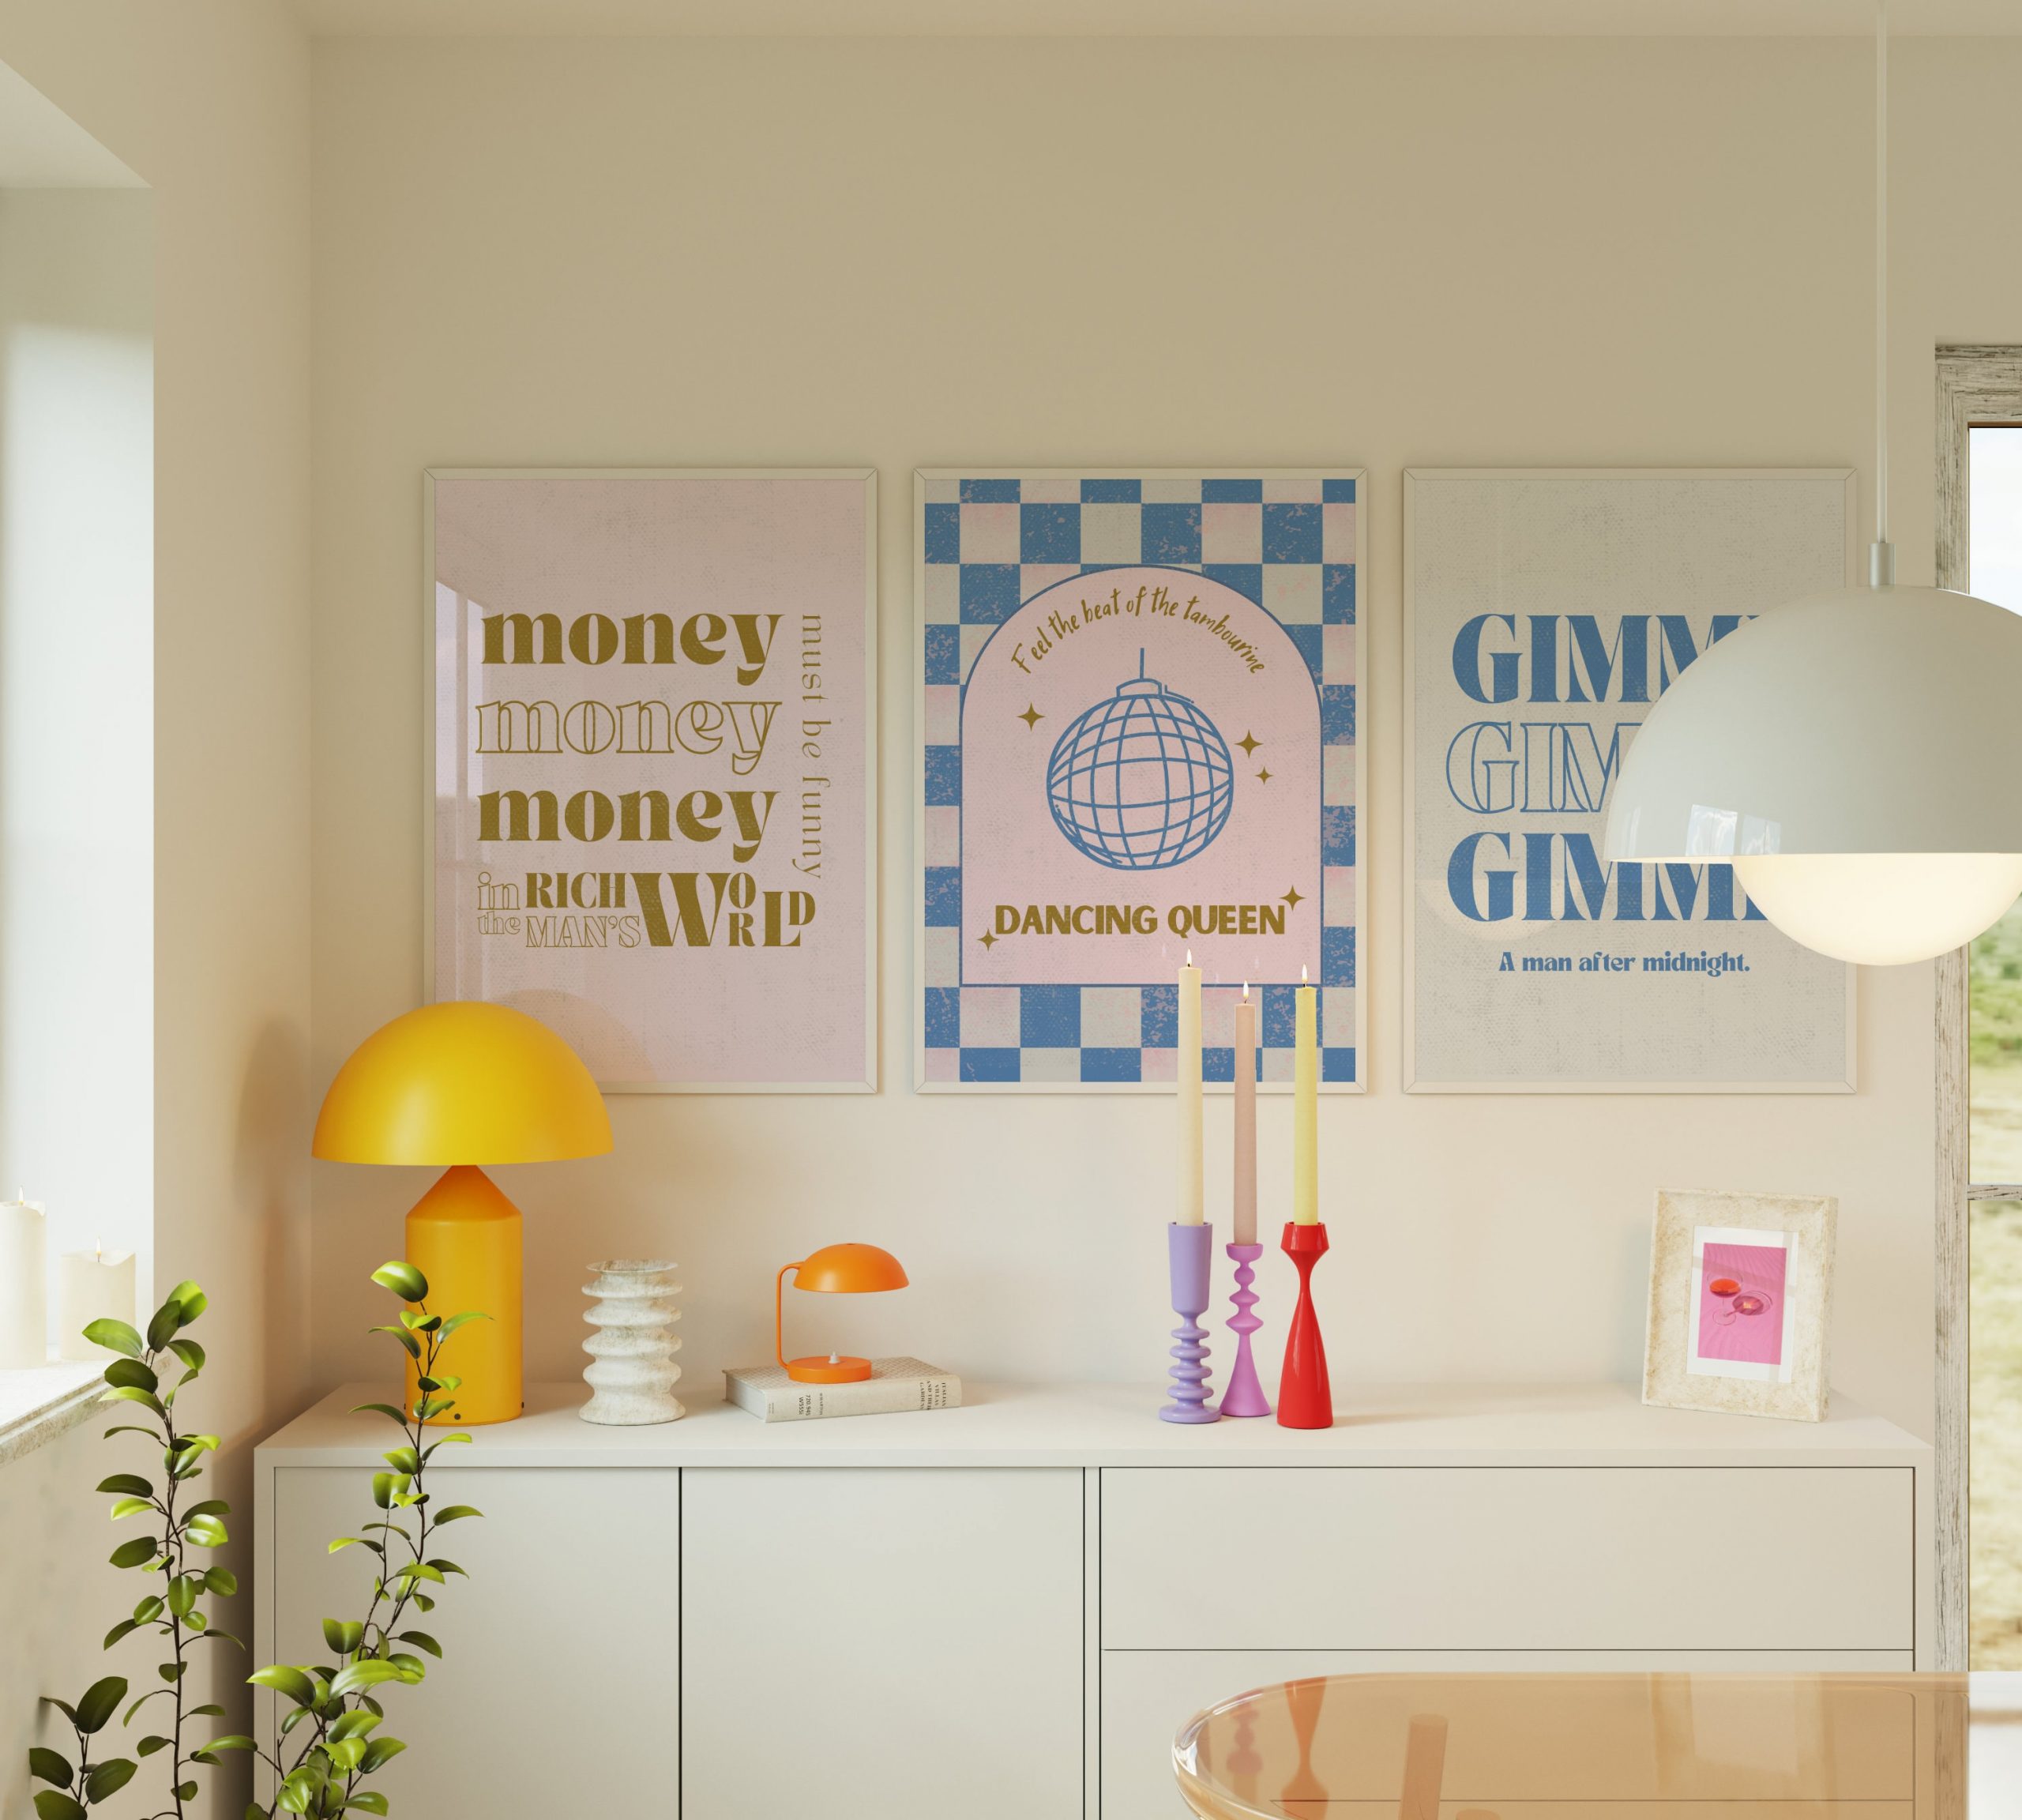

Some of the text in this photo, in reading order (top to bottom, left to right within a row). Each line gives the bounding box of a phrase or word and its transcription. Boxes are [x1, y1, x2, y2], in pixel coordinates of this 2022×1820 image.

[480, 613, 785, 686] money
[1011, 585, 1265, 673] Feel the beat of the tambourine
[1452, 614, 1761, 703] GIMM
[475, 700, 783, 775] money
[792, 615, 832, 879] must be funny
[477, 790, 782, 863] money
[477, 871, 521, 910] in
[525, 872, 627, 908] RICH
[1447, 832, 1769, 922] GIMM
[477, 911, 641, 948] the MAN'S
[994, 905, 1285, 938] DANCING QUEEN
[1498, 950, 1750, 978] A man after midnight.
